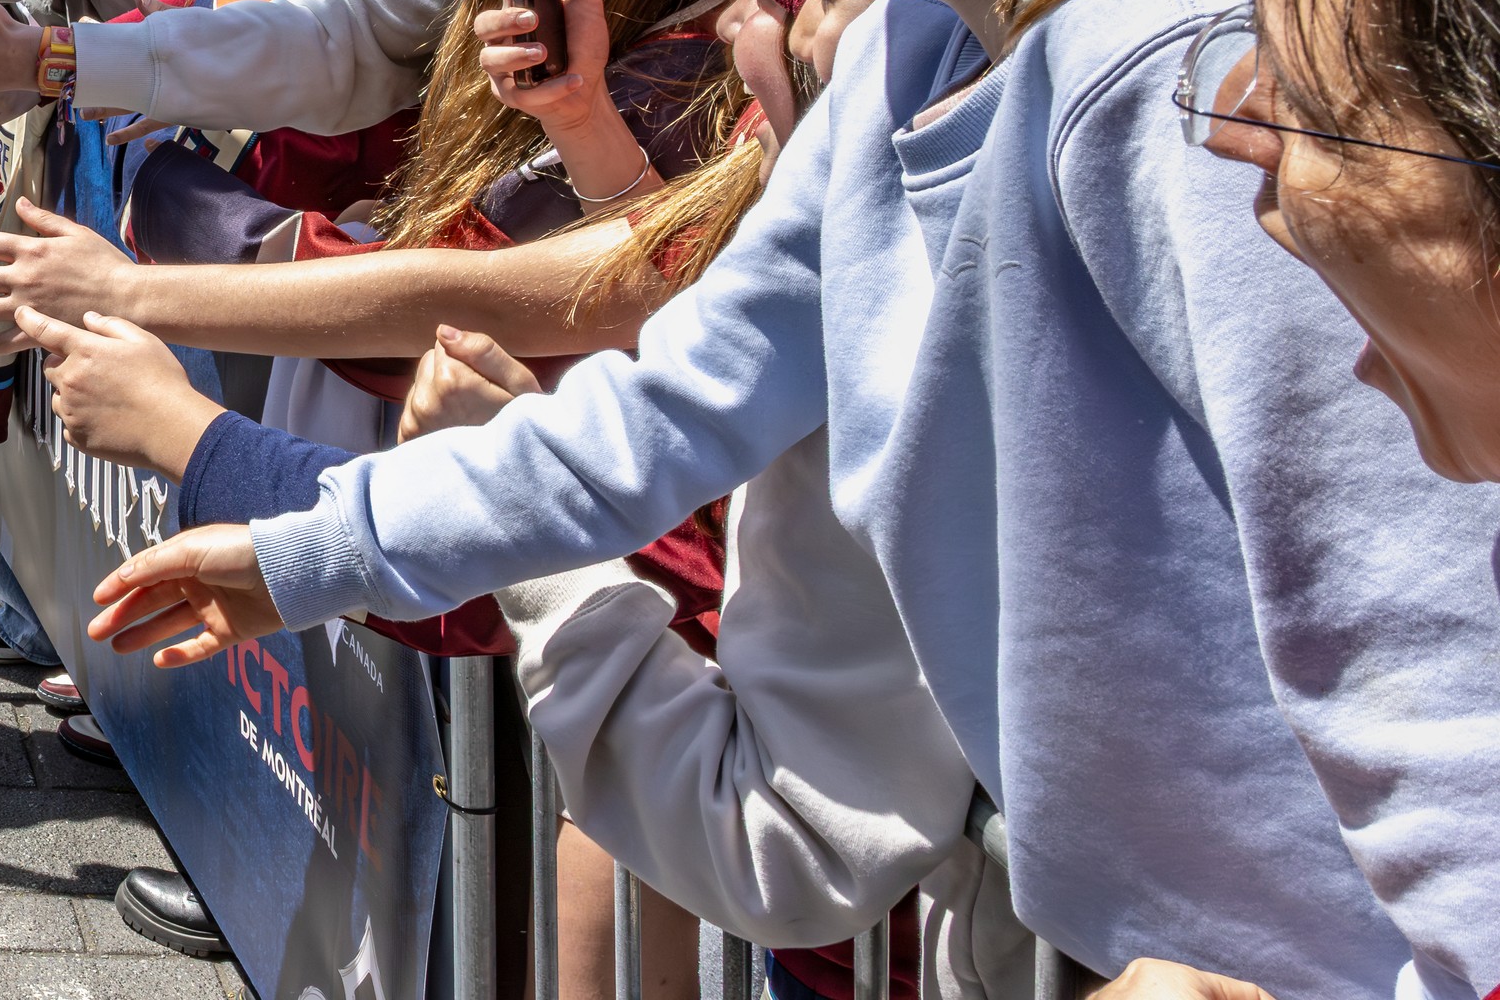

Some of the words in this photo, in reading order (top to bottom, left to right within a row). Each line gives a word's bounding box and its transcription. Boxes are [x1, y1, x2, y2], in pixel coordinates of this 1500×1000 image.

[341, 625, 384, 694] CANADA
[210, 637, 383, 873] ICTOIRE
[240, 709, 258, 752] DE
[262, 737, 338, 860] MONTRÉAL
